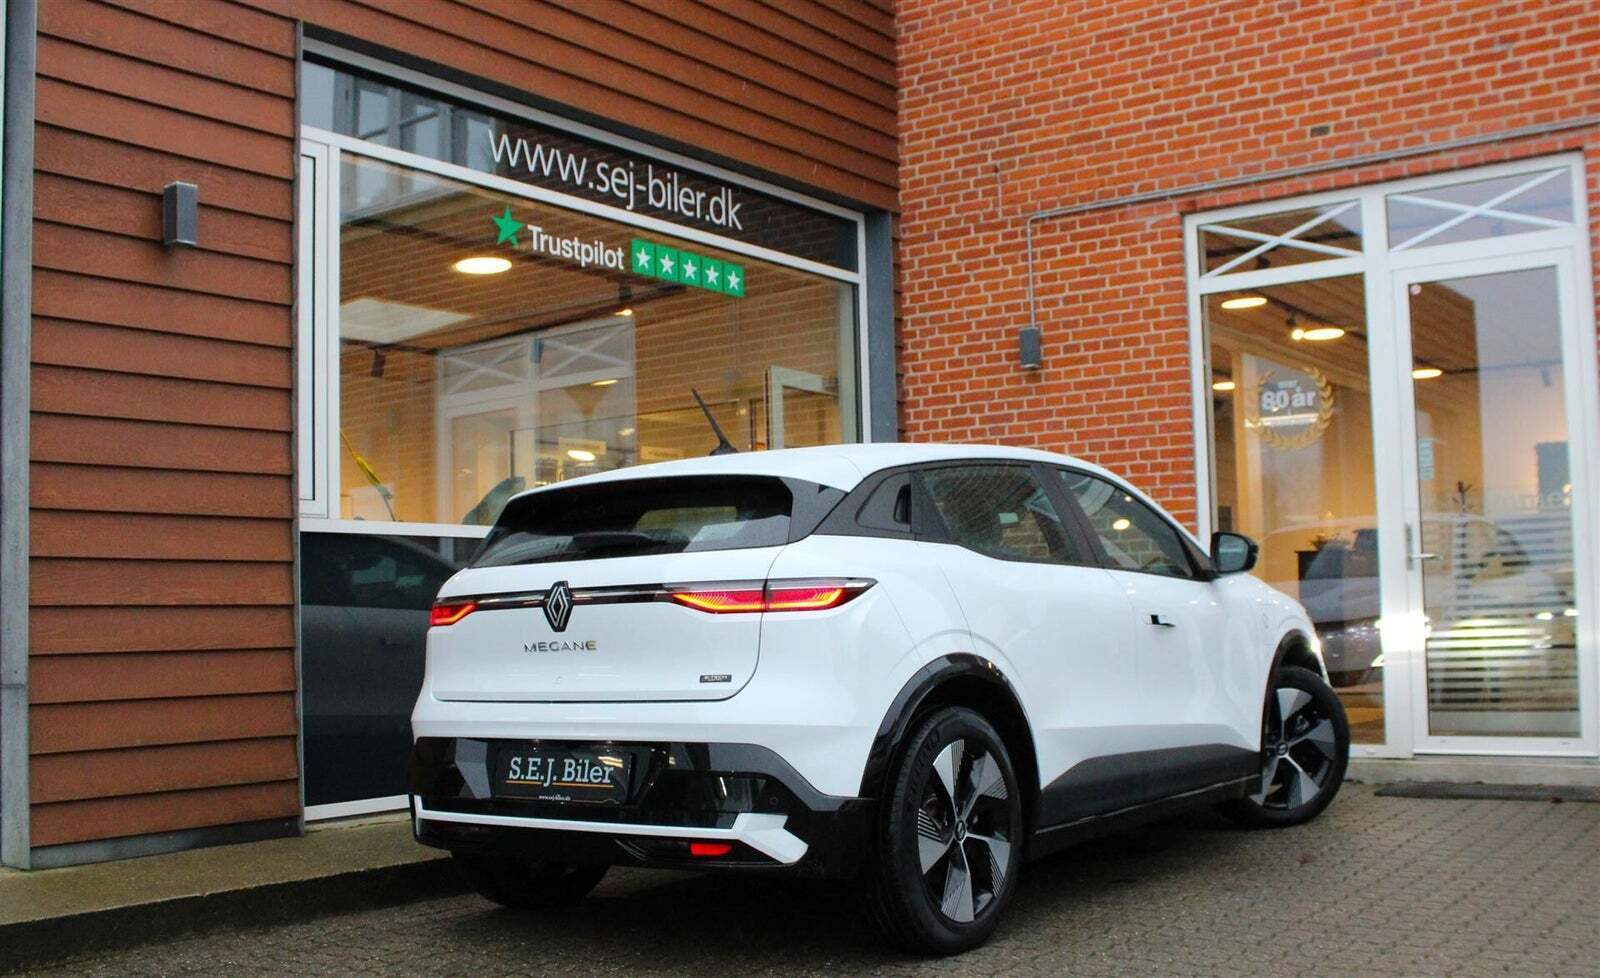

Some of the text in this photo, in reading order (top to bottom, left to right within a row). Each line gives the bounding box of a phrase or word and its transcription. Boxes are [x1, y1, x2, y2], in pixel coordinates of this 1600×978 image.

[488, 131, 743, 231] www.sej-biler.dk
[527, 224, 625, 271] Trustpilot
[1261, 390, 1290, 411] 80
[1291, 385, 1317, 408] år
[523, 640, 597, 654] MEGANE
[508, 756, 614, 788] S.E.J. Biler
